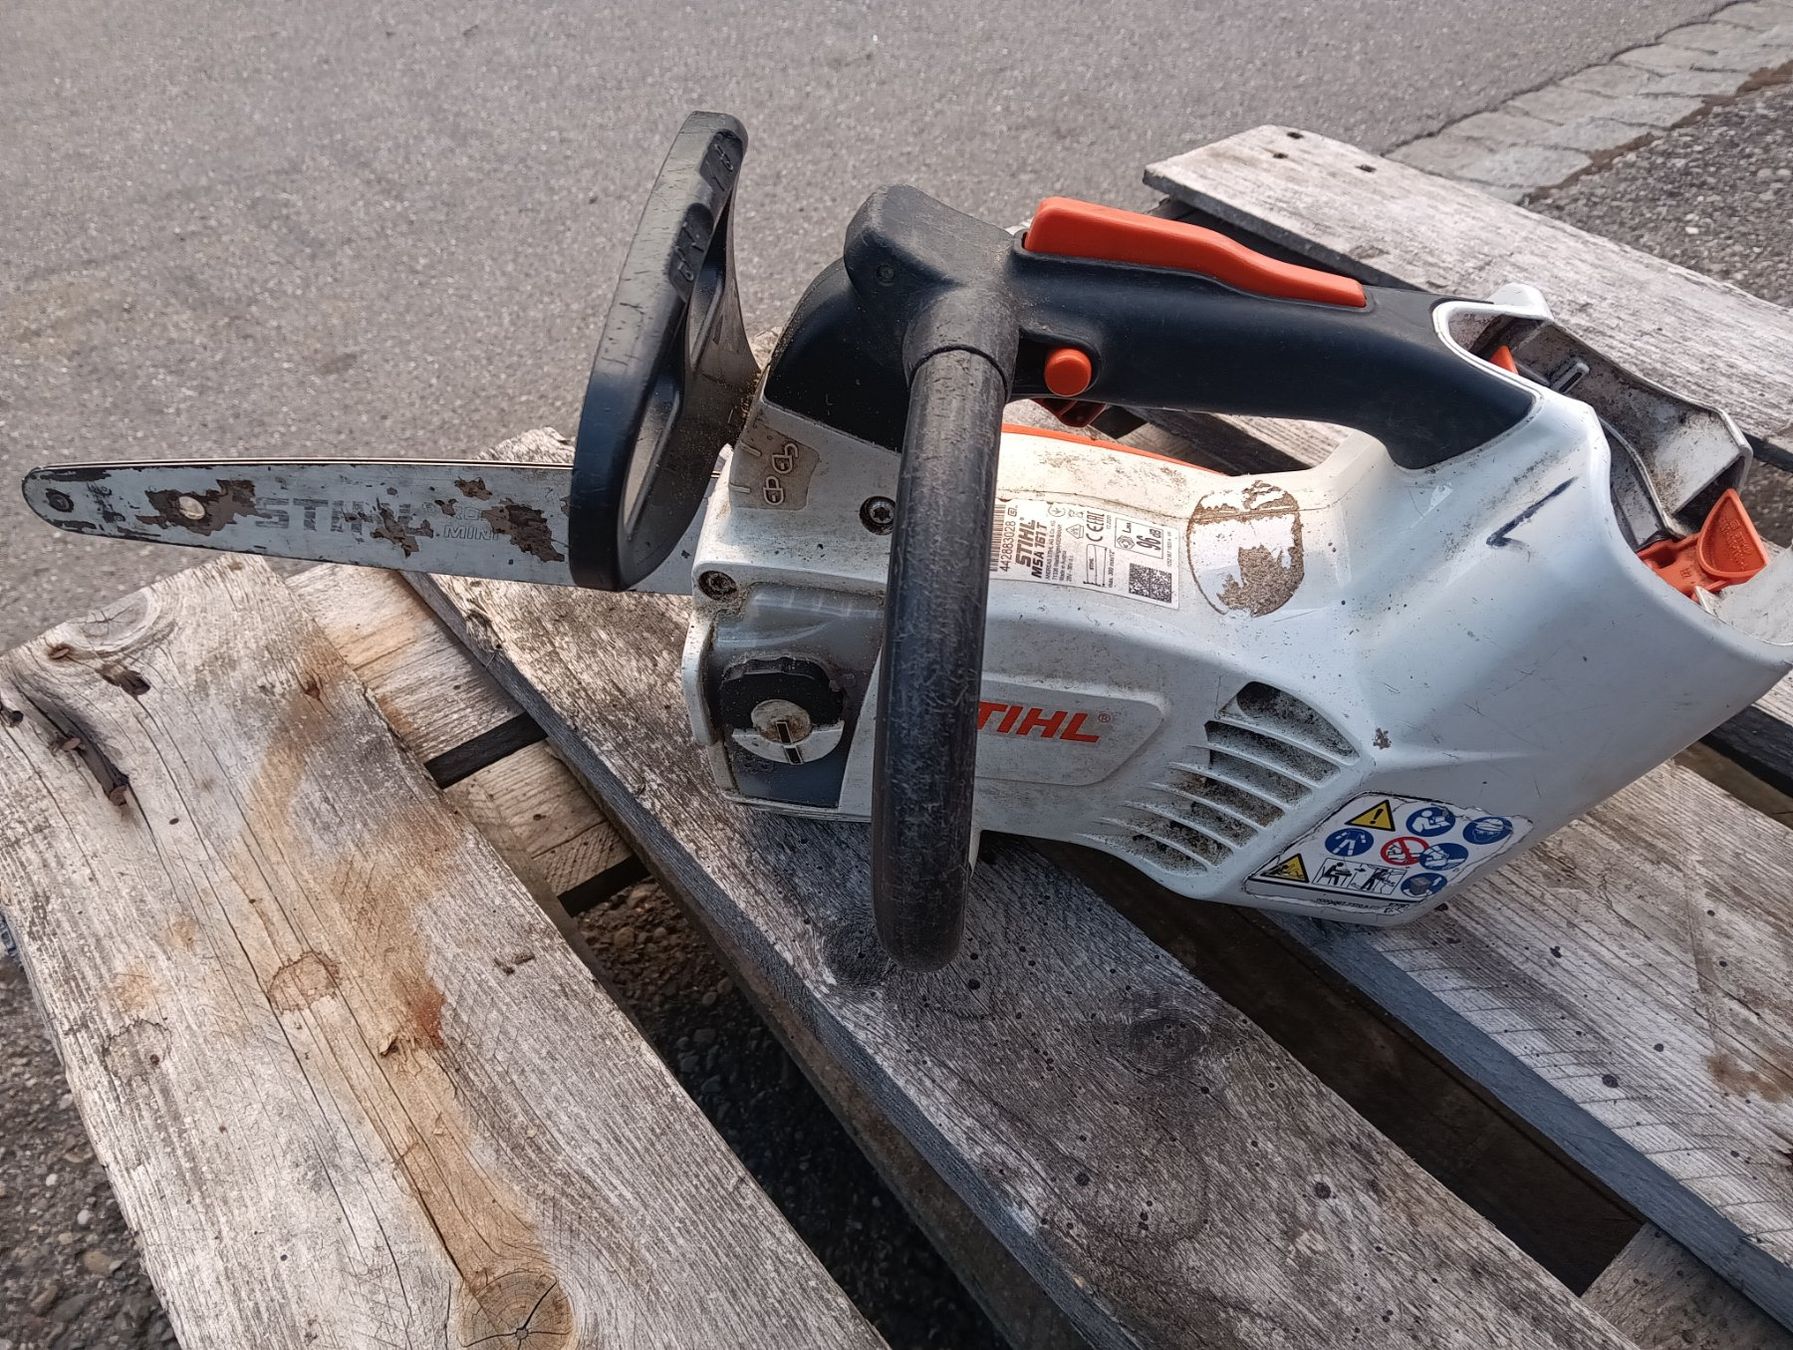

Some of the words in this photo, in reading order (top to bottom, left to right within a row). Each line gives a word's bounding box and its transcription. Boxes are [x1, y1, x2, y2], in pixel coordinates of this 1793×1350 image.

[1034, 530, 1047, 548] 161
[1036, 521, 1047, 532] T
[1136, 535, 1162, 551] 96
[1149, 528, 1162, 539] dB
[999, 520, 1016, 572] 442883028
[1016, 519, 1035, 568] STIHL
[1031, 551, 1044, 579] MSA
[977, 700, 1099, 743] TIHL
